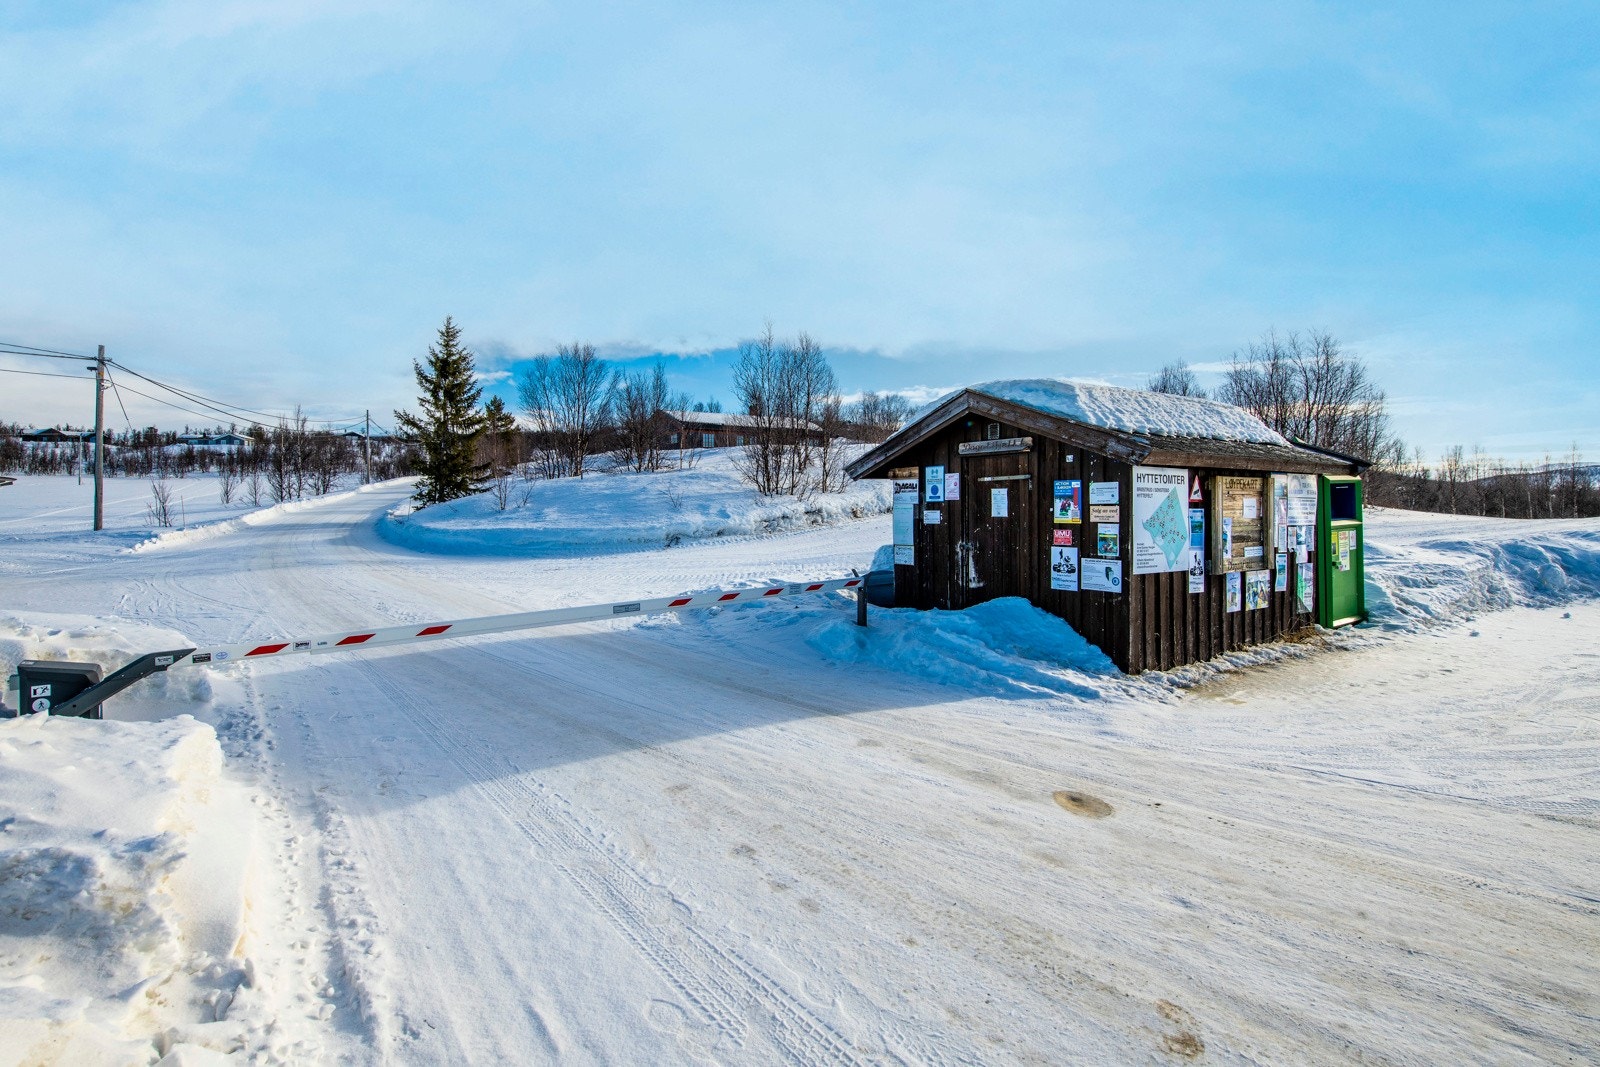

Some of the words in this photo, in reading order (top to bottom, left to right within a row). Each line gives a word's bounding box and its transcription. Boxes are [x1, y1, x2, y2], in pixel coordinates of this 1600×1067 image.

[1136, 473, 1185, 485] HYTTETOMTER
[1225, 478, 1258, 490] LØYPEKART
[894, 482, 918, 494] DAGALI
